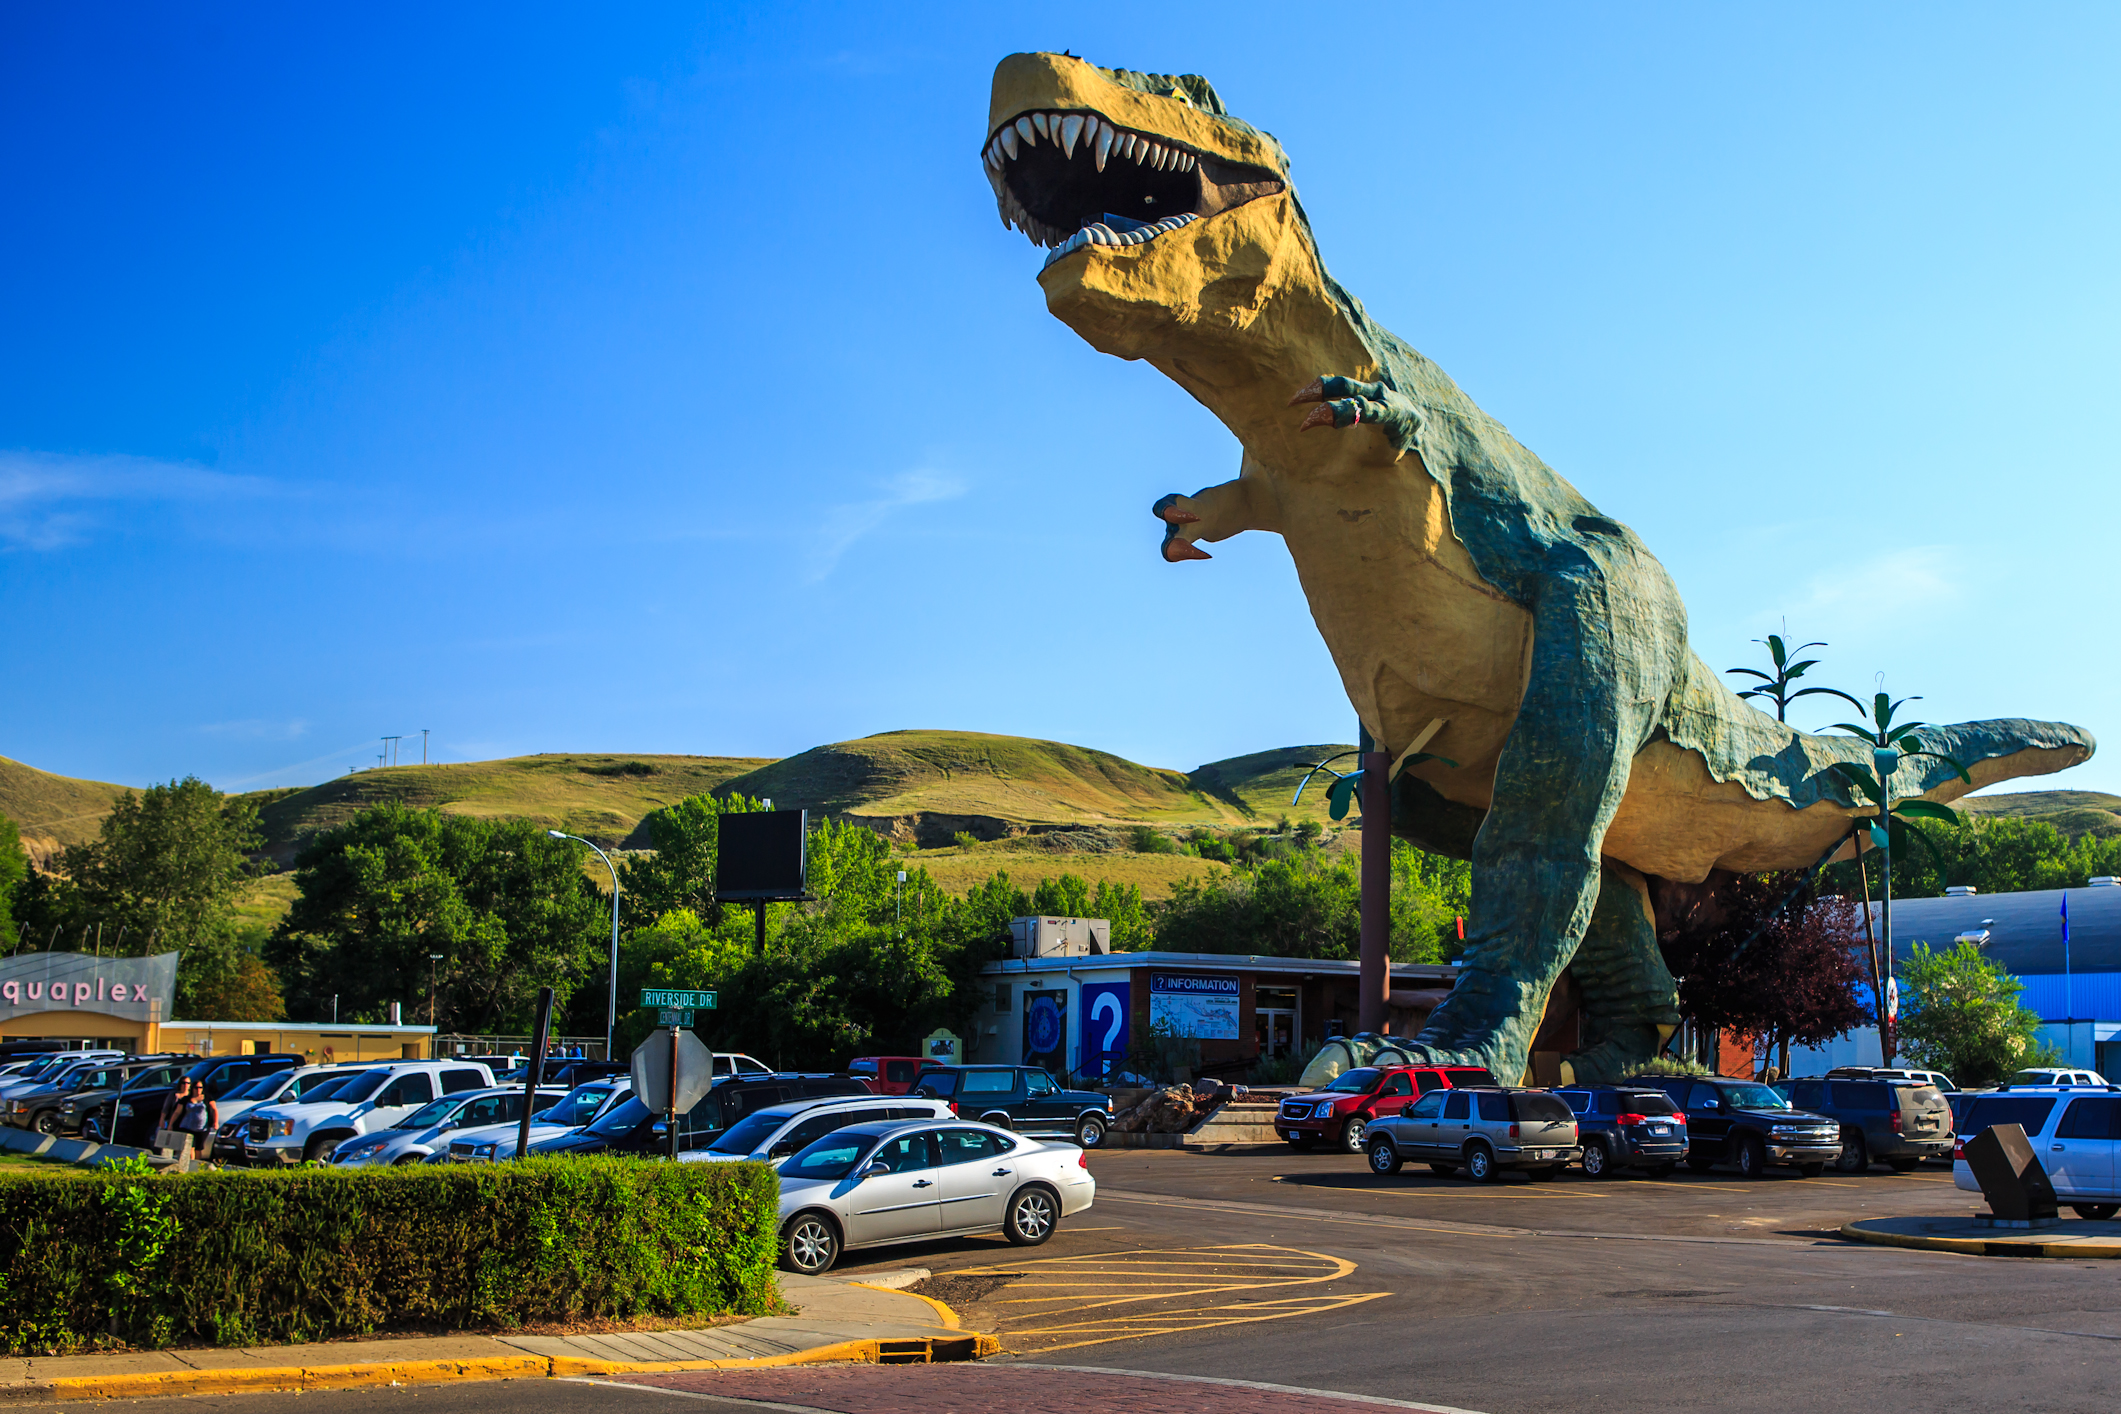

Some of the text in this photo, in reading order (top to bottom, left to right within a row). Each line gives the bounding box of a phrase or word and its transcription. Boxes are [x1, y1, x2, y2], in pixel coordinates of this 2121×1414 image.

[1167, 978, 1237, 991] INFORMATION
[2, 977, 148, 1006] quaplex
[645, 992, 712, 1006] RIVERSIDE DR
[684, 1012, 691, 1024] DR
